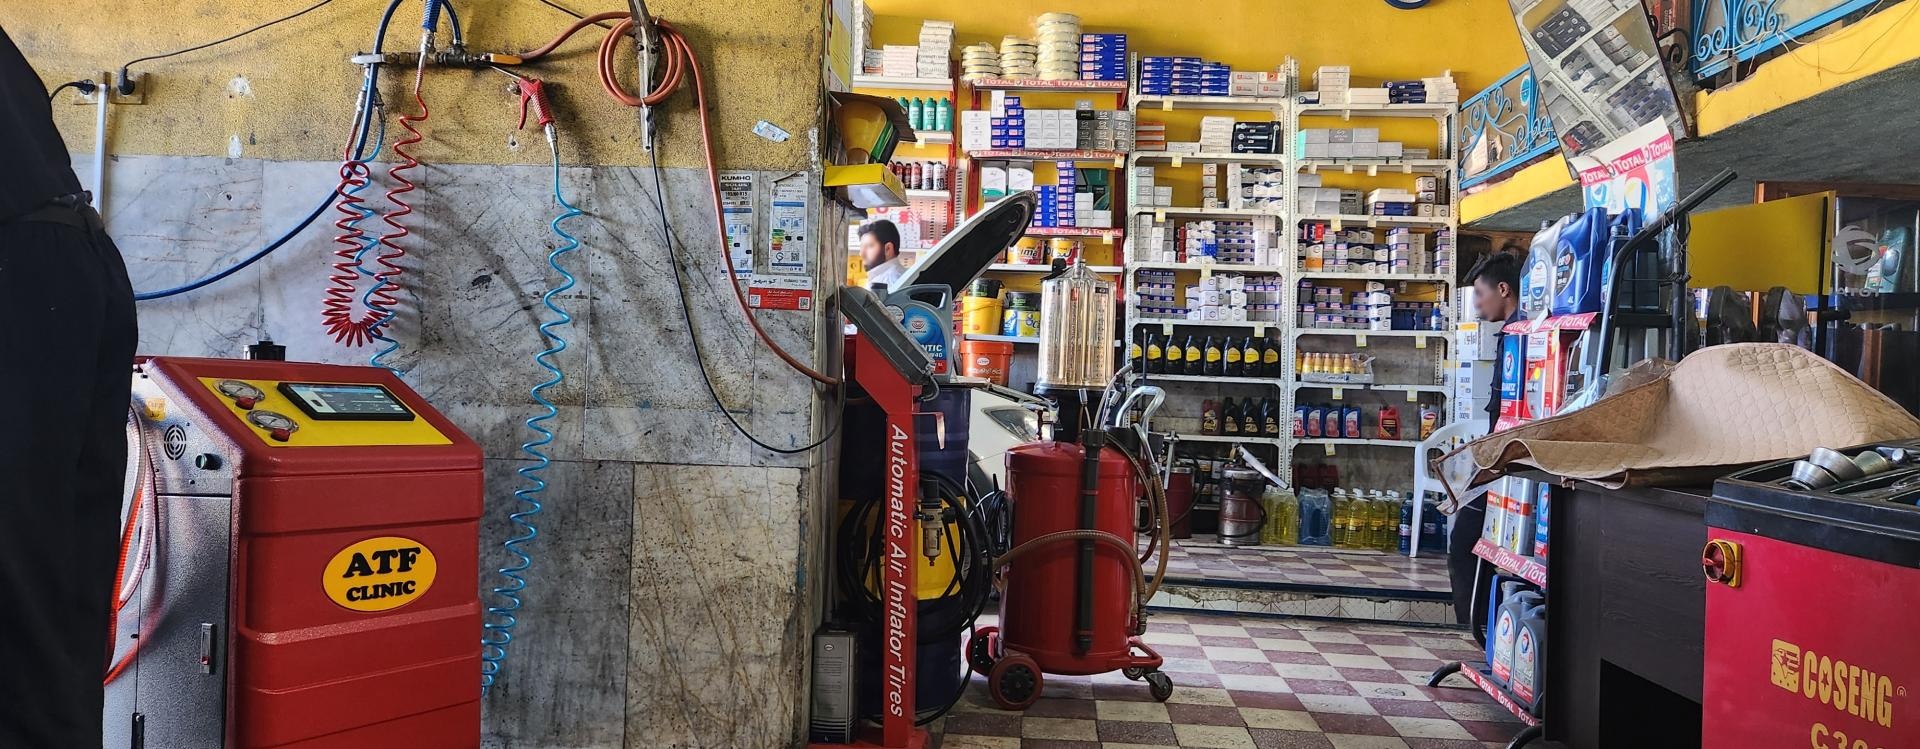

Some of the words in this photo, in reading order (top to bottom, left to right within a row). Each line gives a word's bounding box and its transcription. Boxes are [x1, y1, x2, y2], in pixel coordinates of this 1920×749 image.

[1581, 170, 1608, 184] TOTAL
[1614, 154, 1645, 170] TOTAL
[1651, 140, 1673, 157] TOTAL
[1560, 316, 1588, 327] TOTAL
[891, 424, 908, 539] Automatic
[342, 547, 421, 578] ATF
[891, 542, 907, 578] Air
[1501, 552, 1520, 571] TOTAL
[1528, 566, 1546, 584] TOTA
[346, 580, 416, 602] CLINIC
[889, 580, 907, 662] Inflator
[889, 664, 906, 717] Tires
[1462, 664, 1477, 681] TOTAL
[1479, 676, 1494, 696] TOTAL
[1497, 691, 1514, 713] TOTAL
[1803, 650, 1893, 728] COSENG
